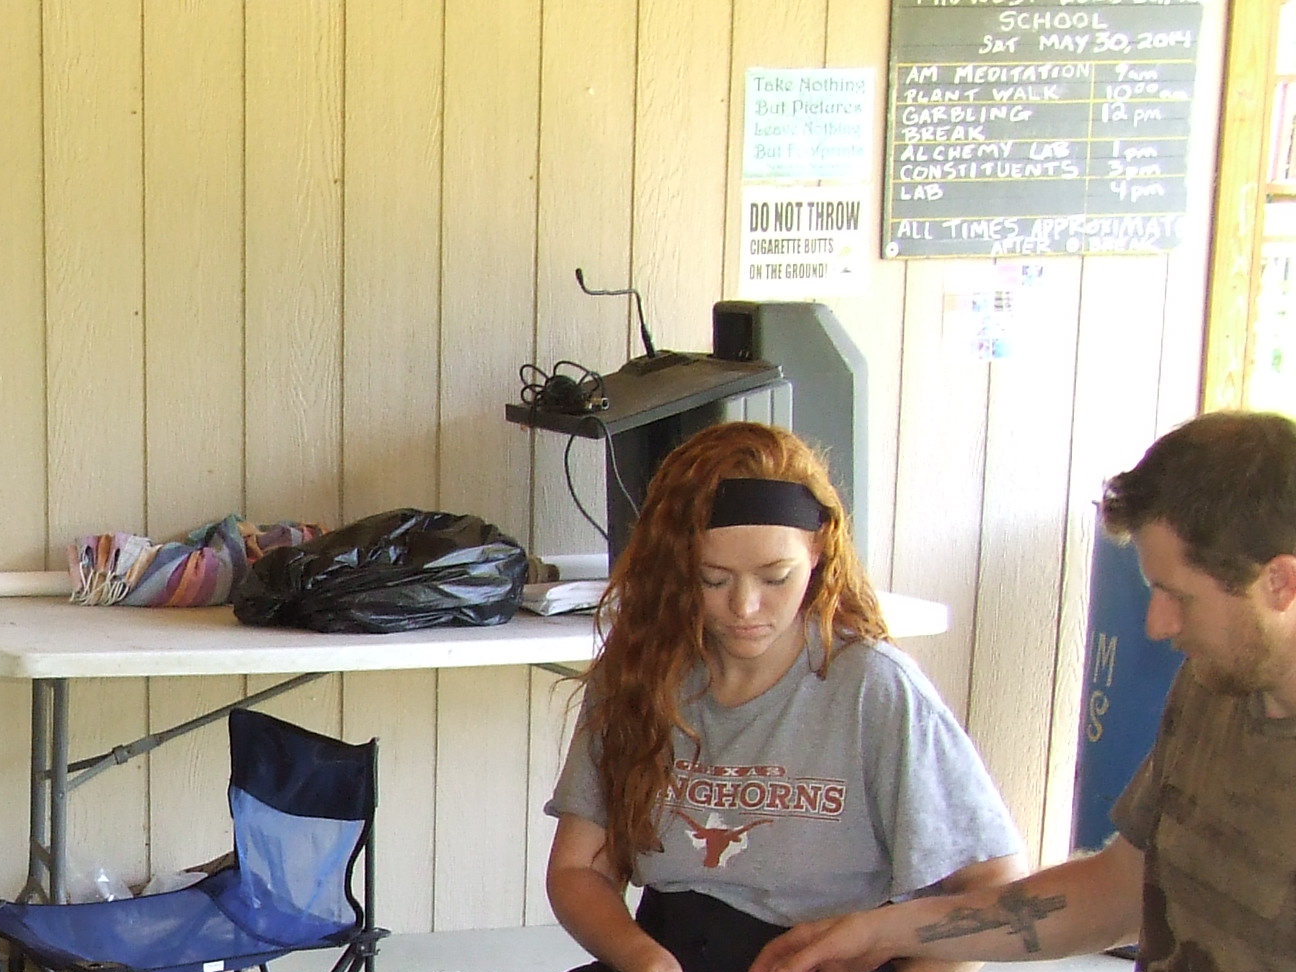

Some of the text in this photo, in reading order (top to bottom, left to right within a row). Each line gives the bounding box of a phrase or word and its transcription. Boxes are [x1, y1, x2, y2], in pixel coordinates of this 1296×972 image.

[999, 11, 1107, 31] SCHOOL
[1039, 33, 1089, 54] MAY
[906, 63, 1090, 84] AM MEDITATION
[754, 77, 865, 95] Take Nothing
[904, 85, 1060, 103] PLANT WALK
[755, 100, 862, 116] But Pictures
[902, 105, 1033, 126] GARBLING
[901, 125, 986, 142] BREAK
[900, 140, 1070, 162] ALCHEMY LAB
[900, 160, 1079, 180] CONSTITUENTS
[900, 184, 944, 201] LAB
[749, 200, 860, 232] DO NOT THROW
[898, 220, 932, 240] ALL
[942, 219, 1019, 240] TIMES
[750, 238, 834, 255] CIGARETTE BUTTS
[749, 264, 762, 280] ON
[765, 263, 782, 280] THE
[657, 775, 847, 816] NGHORNS
